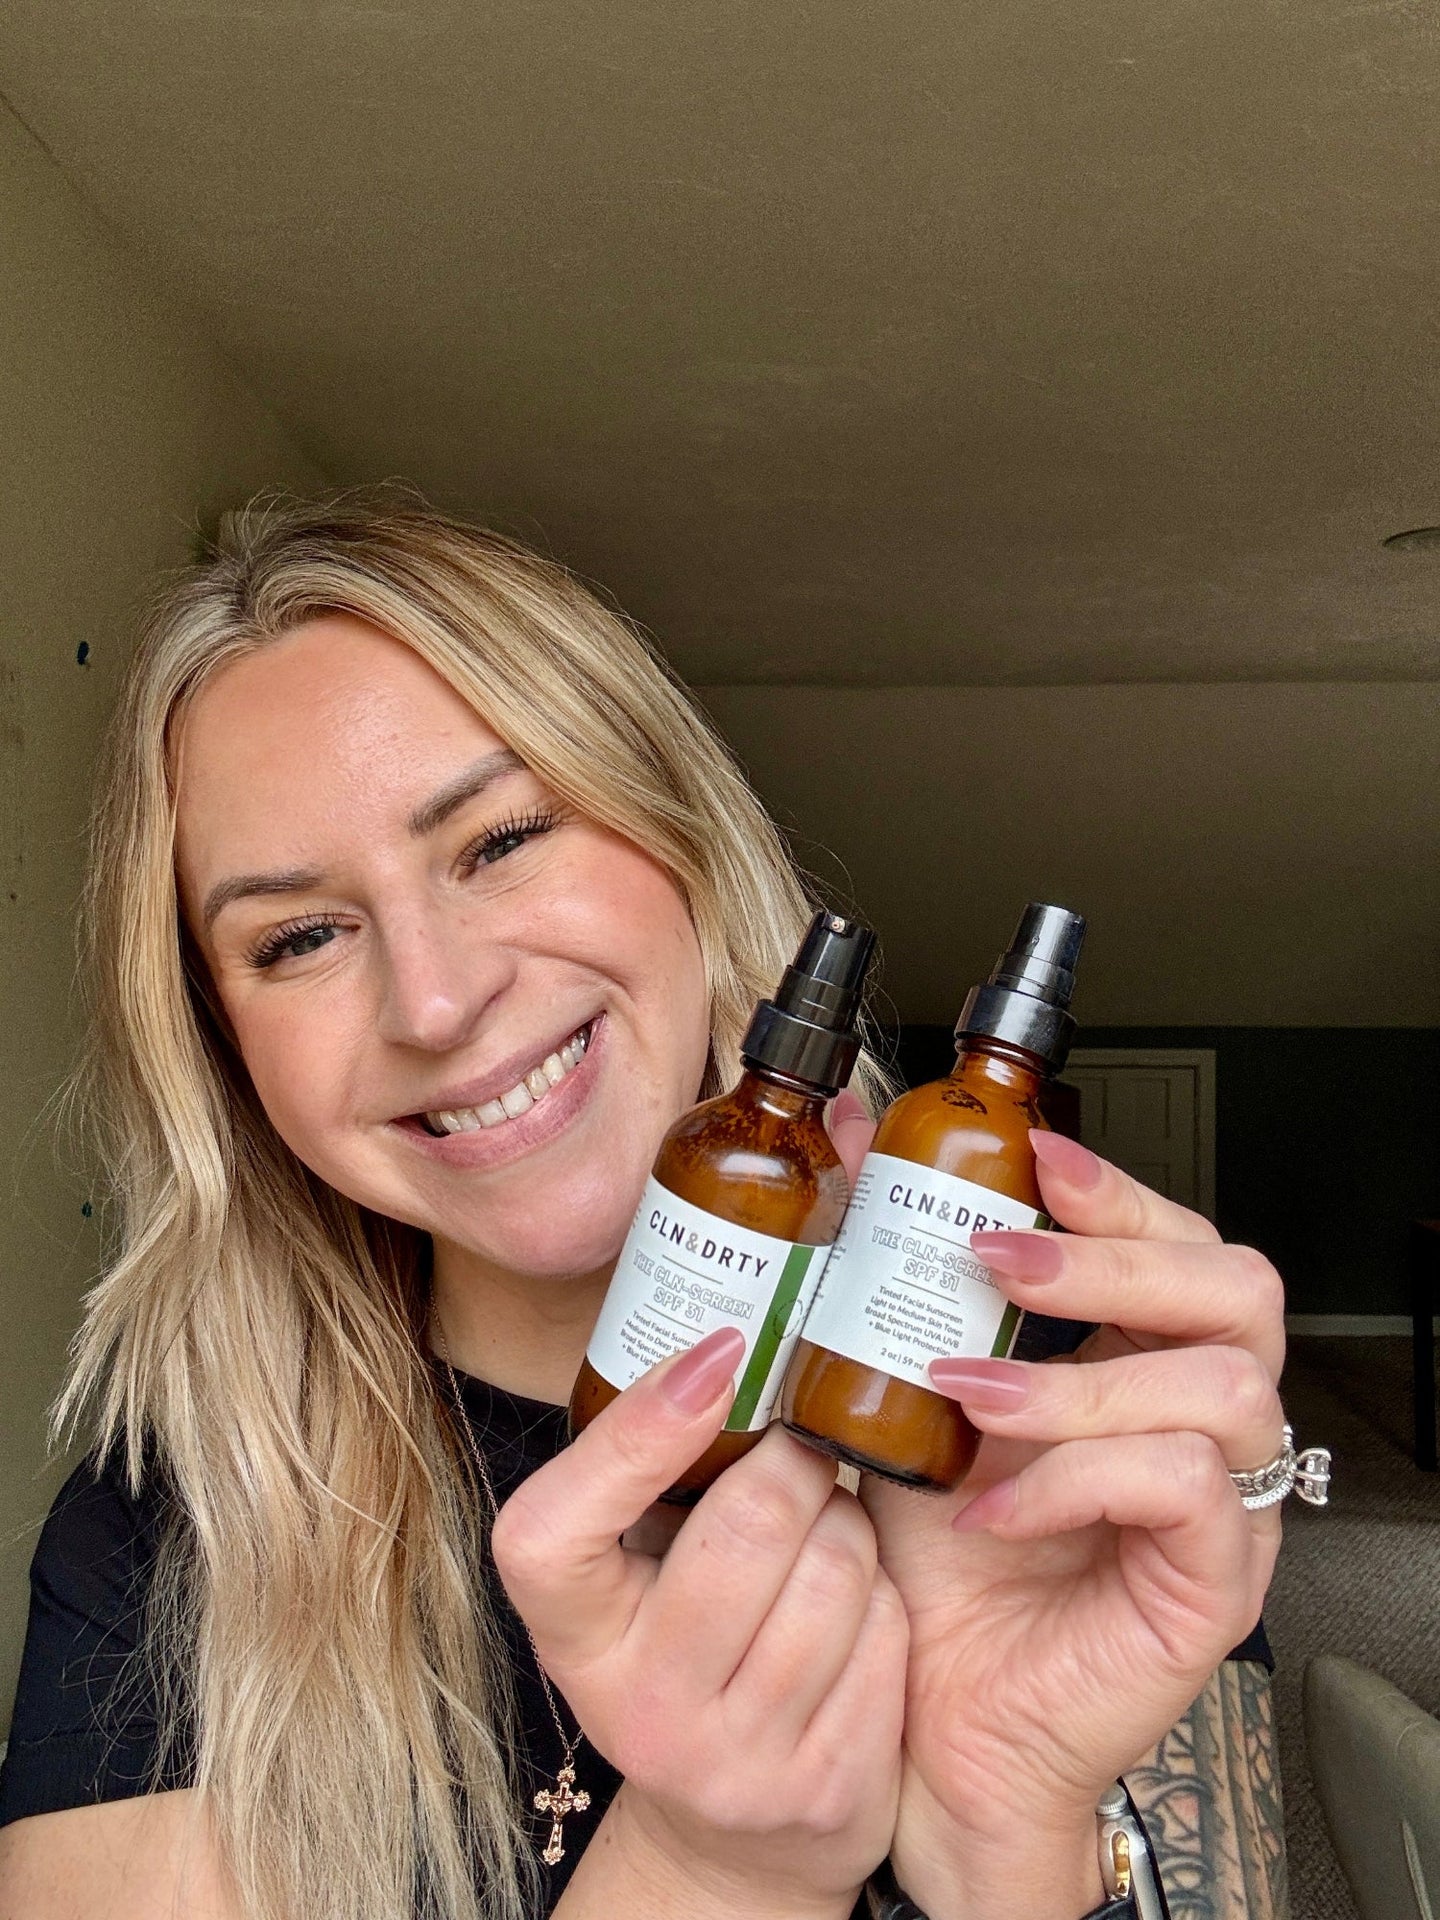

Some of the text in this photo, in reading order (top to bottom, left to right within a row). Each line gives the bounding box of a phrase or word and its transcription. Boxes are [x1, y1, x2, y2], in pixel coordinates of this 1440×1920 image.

[889, 1184, 1012, 1232] CLN&DRT
[650, 1210, 769, 1277] CLN&DRTY
[872, 1226, 999, 1289] THE CLN-SCREE
[633, 1248, 754, 1320] THE CLN-SCREEN
[904, 1258, 960, 1292] SPF 31
[653, 1286, 705, 1322] SPF 31
[871, 1296, 963, 1337] Light to Medium Skin Tones
[880, 1286, 963, 1324] Tinted Facial Sunscreen
[620, 1328, 636, 1345] Broad
[625, 1318, 646, 1337] Medium
[646, 1332, 654, 1342] to
[654, 1337, 671, 1352] Deep
[632, 1310, 695, 1347] Tinted Facial Sunscr
[865, 1306, 959, 1349] Broad Spectrum UVA UVB
[874, 1322, 891, 1334] Blue
[892, 1329, 912, 1343] Light
[912, 1337, 950, 1358] Protection
[626, 1346, 640, 1359] Blue
[881, 1347, 887, 1356] 2
[902, 1356, 914, 1366] 59
[914, 1362, 925, 1370] ml
[629, 1371, 635, 1380] 2
